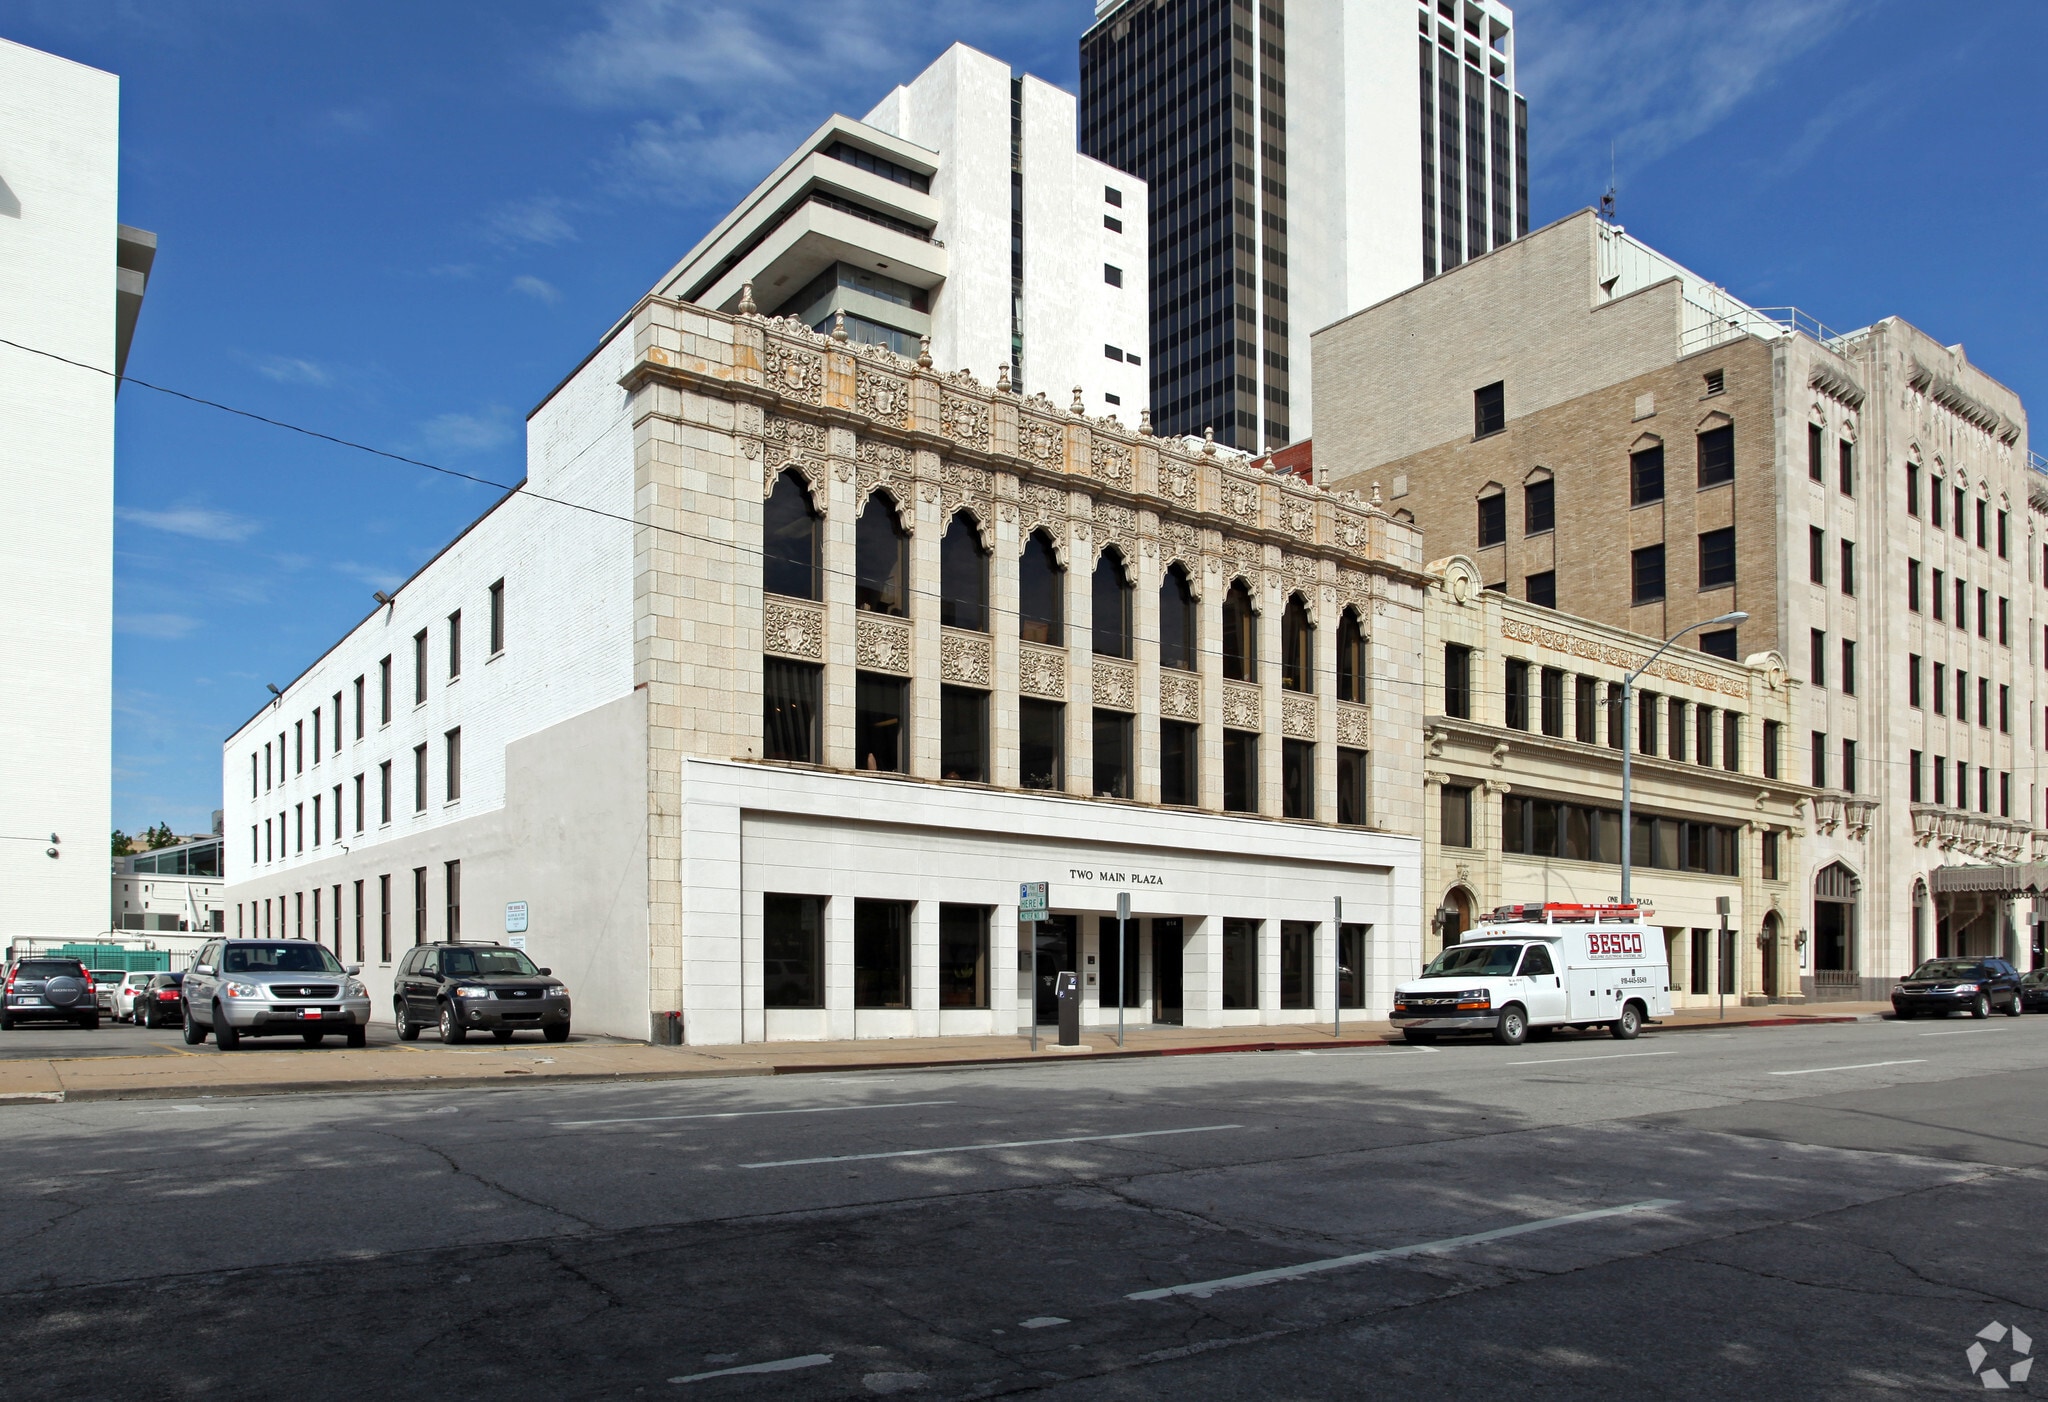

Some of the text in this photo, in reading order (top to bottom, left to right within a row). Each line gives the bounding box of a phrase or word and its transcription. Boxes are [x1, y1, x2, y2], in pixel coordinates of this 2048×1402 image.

[1069, 869, 1163, 885] TWO MAIN PLAZA
[1021, 898, 1037, 908] HERE
[1607, 895, 1618, 903] ONE
[1587, 934, 1642, 954] BESCO
